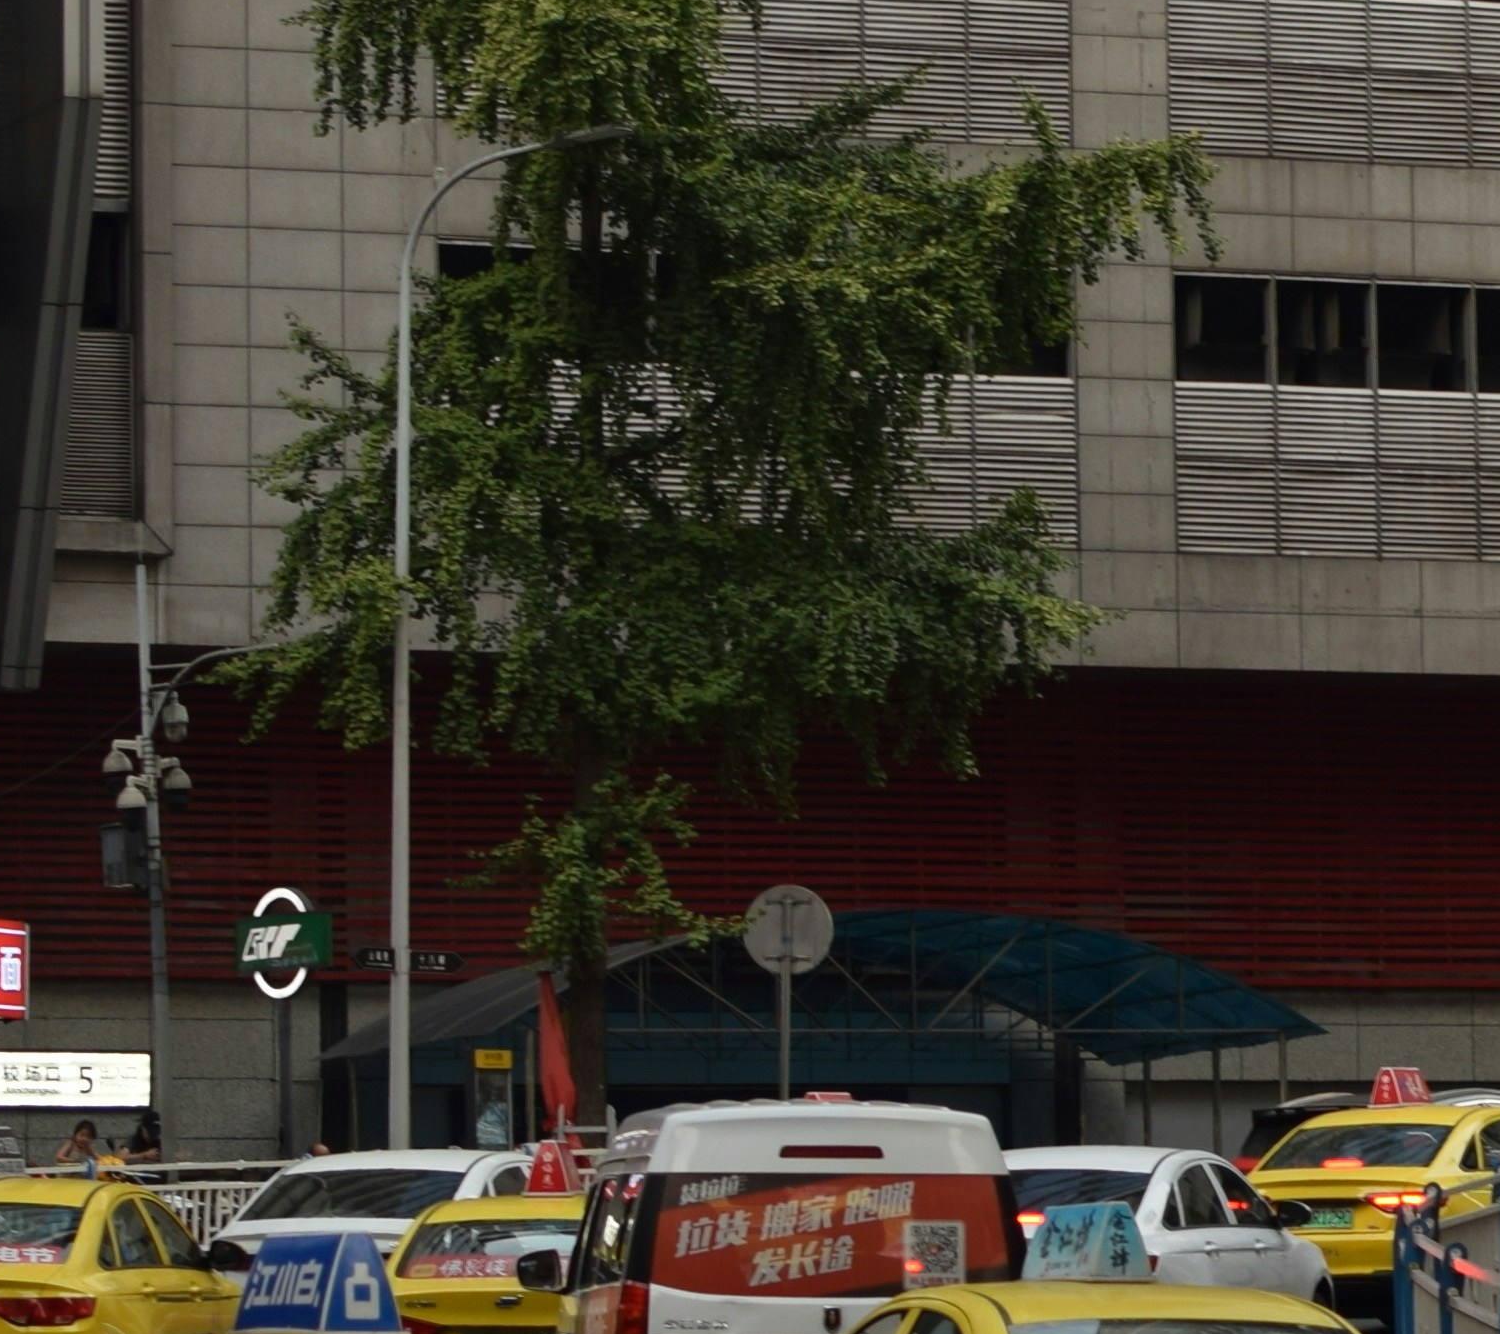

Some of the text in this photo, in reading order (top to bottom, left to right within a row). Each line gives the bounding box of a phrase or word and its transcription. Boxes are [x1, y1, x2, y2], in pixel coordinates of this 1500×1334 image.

[79, 1065, 94, 1095] 5
[675, 1210, 752, 1258] 拉货
[759, 1194, 838, 1241] 搬家
[749, 1235, 855, 1287] 发长途
